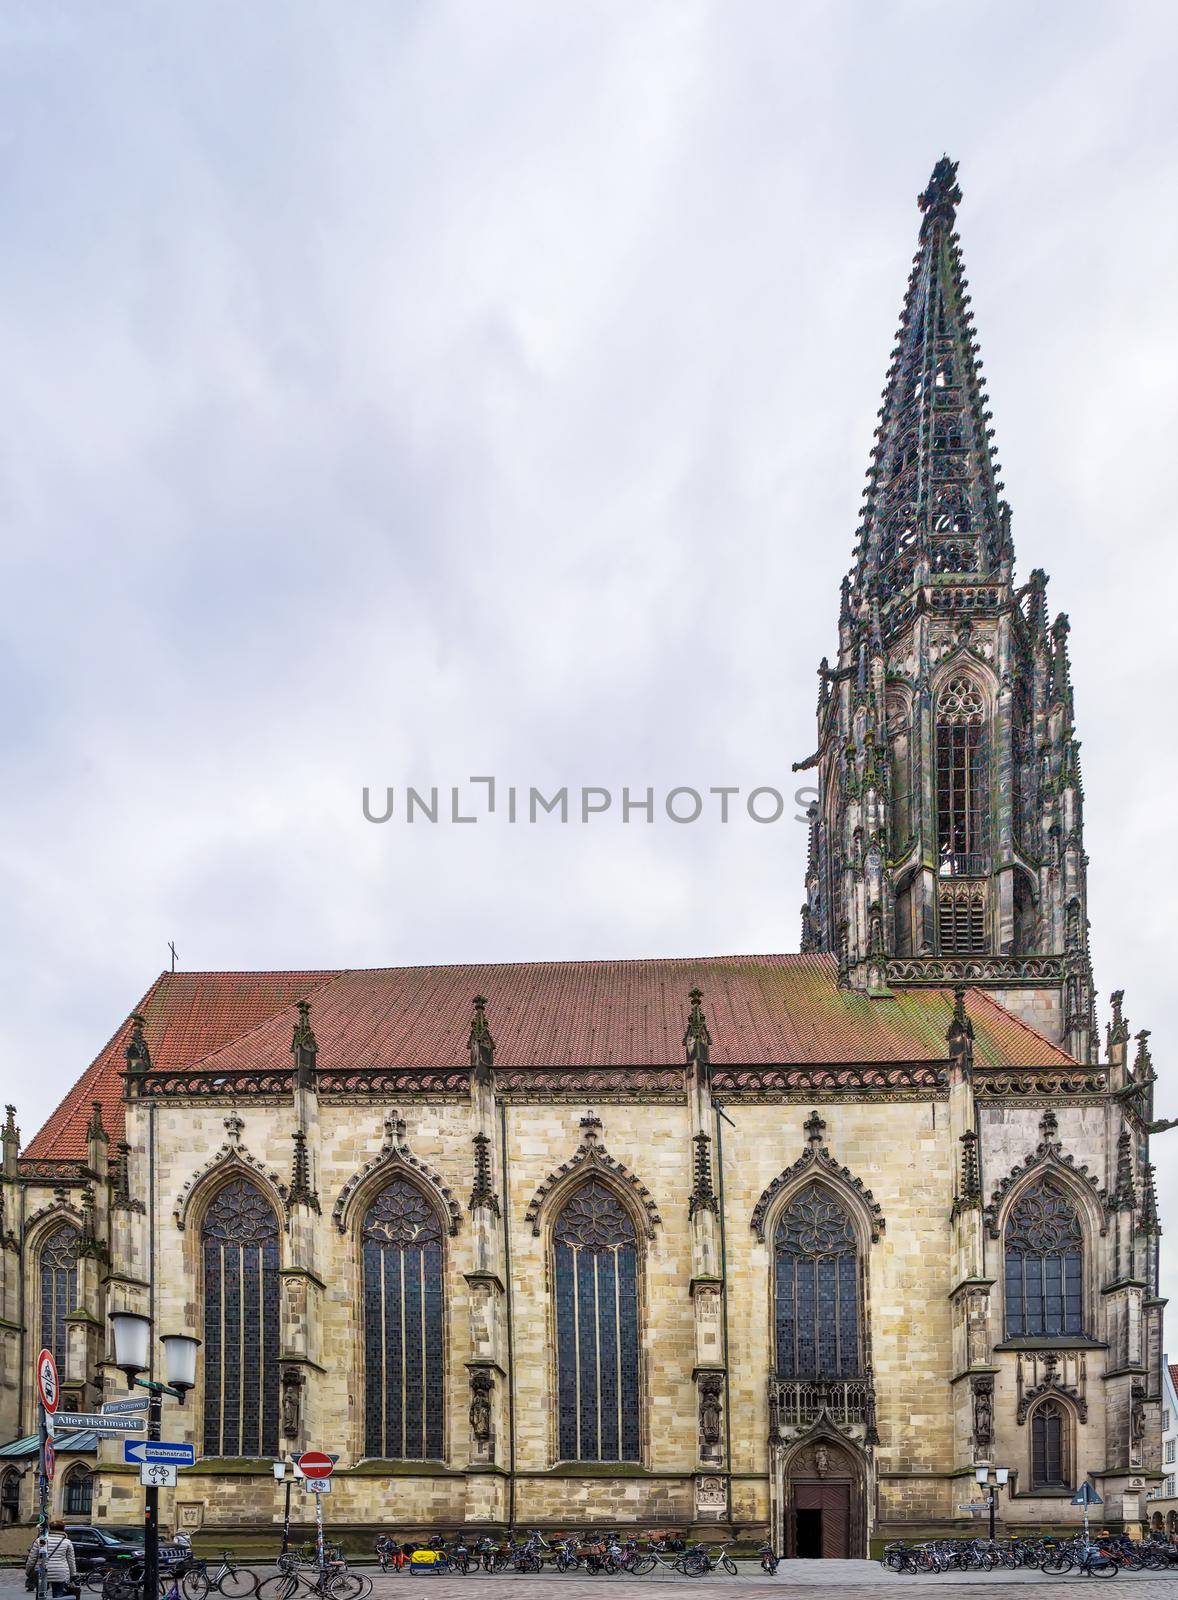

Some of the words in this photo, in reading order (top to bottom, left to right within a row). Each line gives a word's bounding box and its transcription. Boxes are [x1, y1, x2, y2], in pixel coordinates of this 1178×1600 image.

[57, 1416, 82, 1425] Alter
[86, 1417, 137, 1428] Fischmarkt
[145, 1449, 191, 1458] Einbahnstraße
